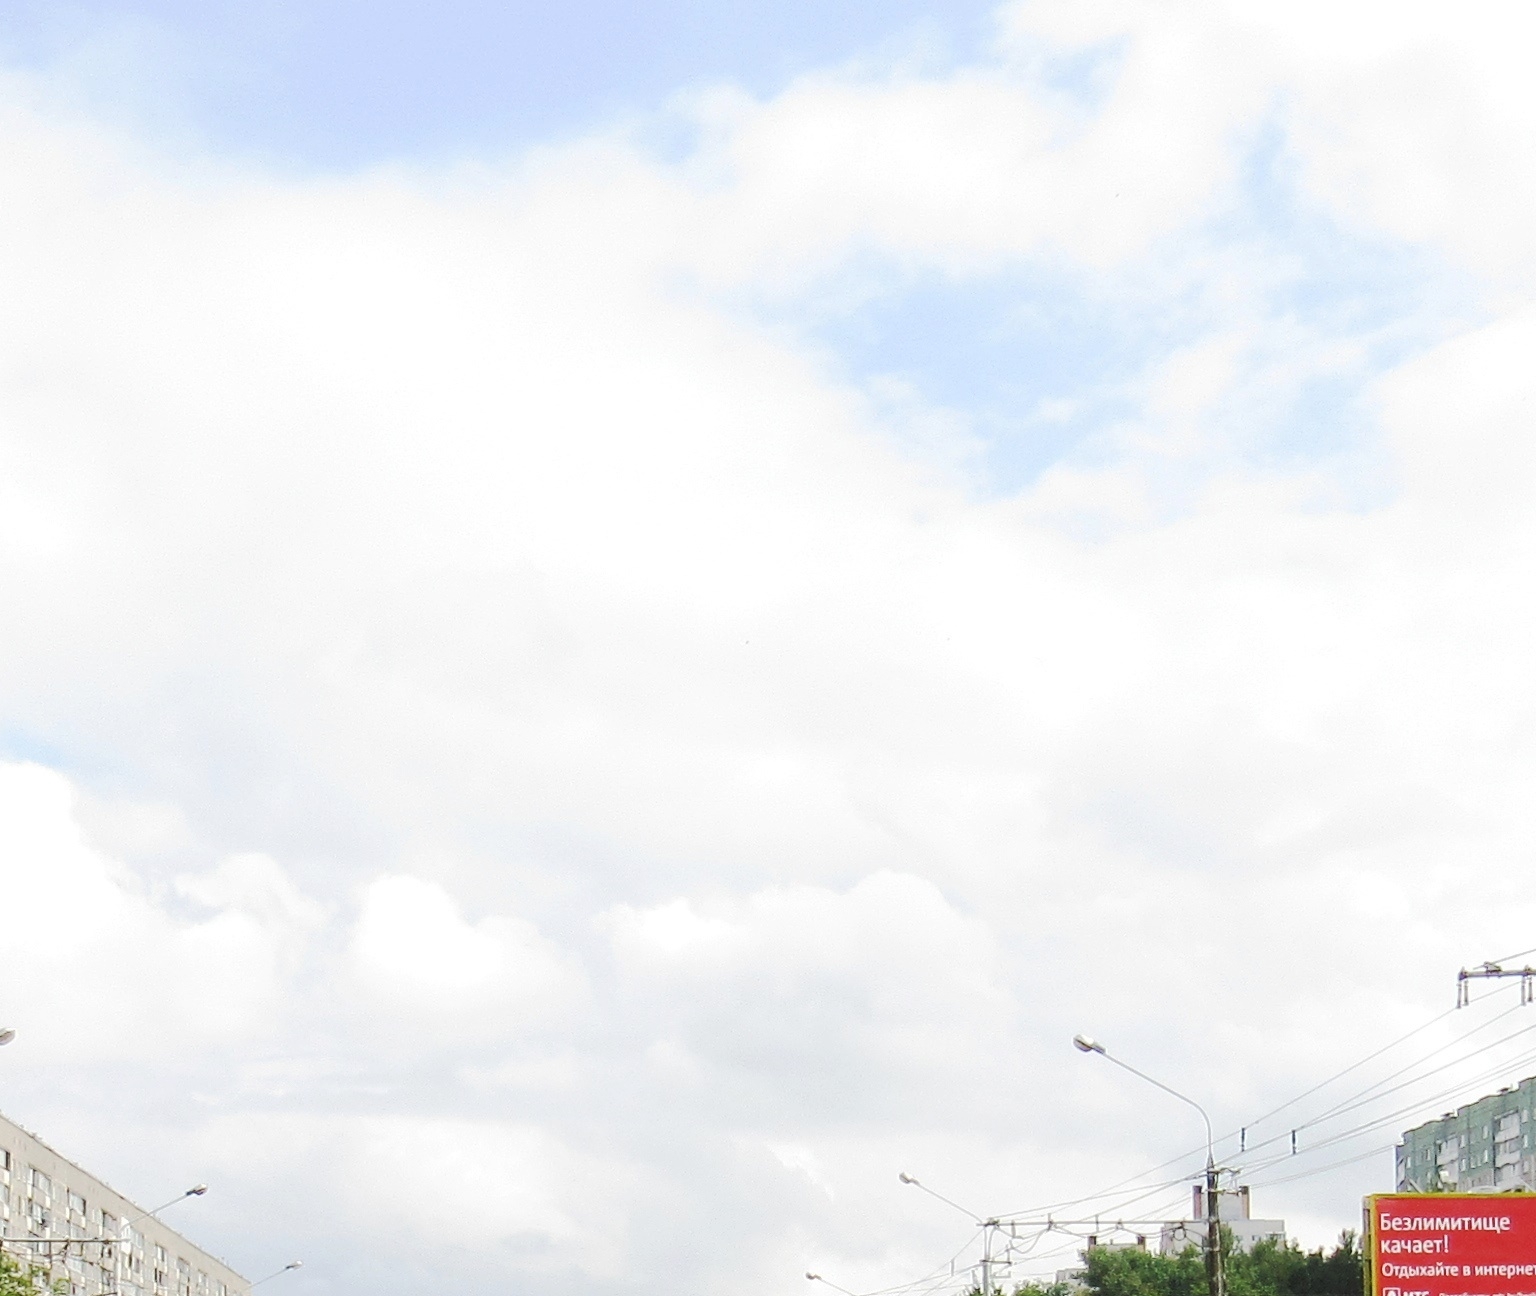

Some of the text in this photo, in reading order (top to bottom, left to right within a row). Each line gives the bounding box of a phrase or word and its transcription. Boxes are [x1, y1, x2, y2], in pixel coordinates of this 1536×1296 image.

[1380, 1213, 1511, 1233] Безлимитище
[1381, 1235, 1449, 1254] качает!
[1382, 1262, 1459, 1279] Отдыхайте
[1463, 1267, 1471, 1277] в
